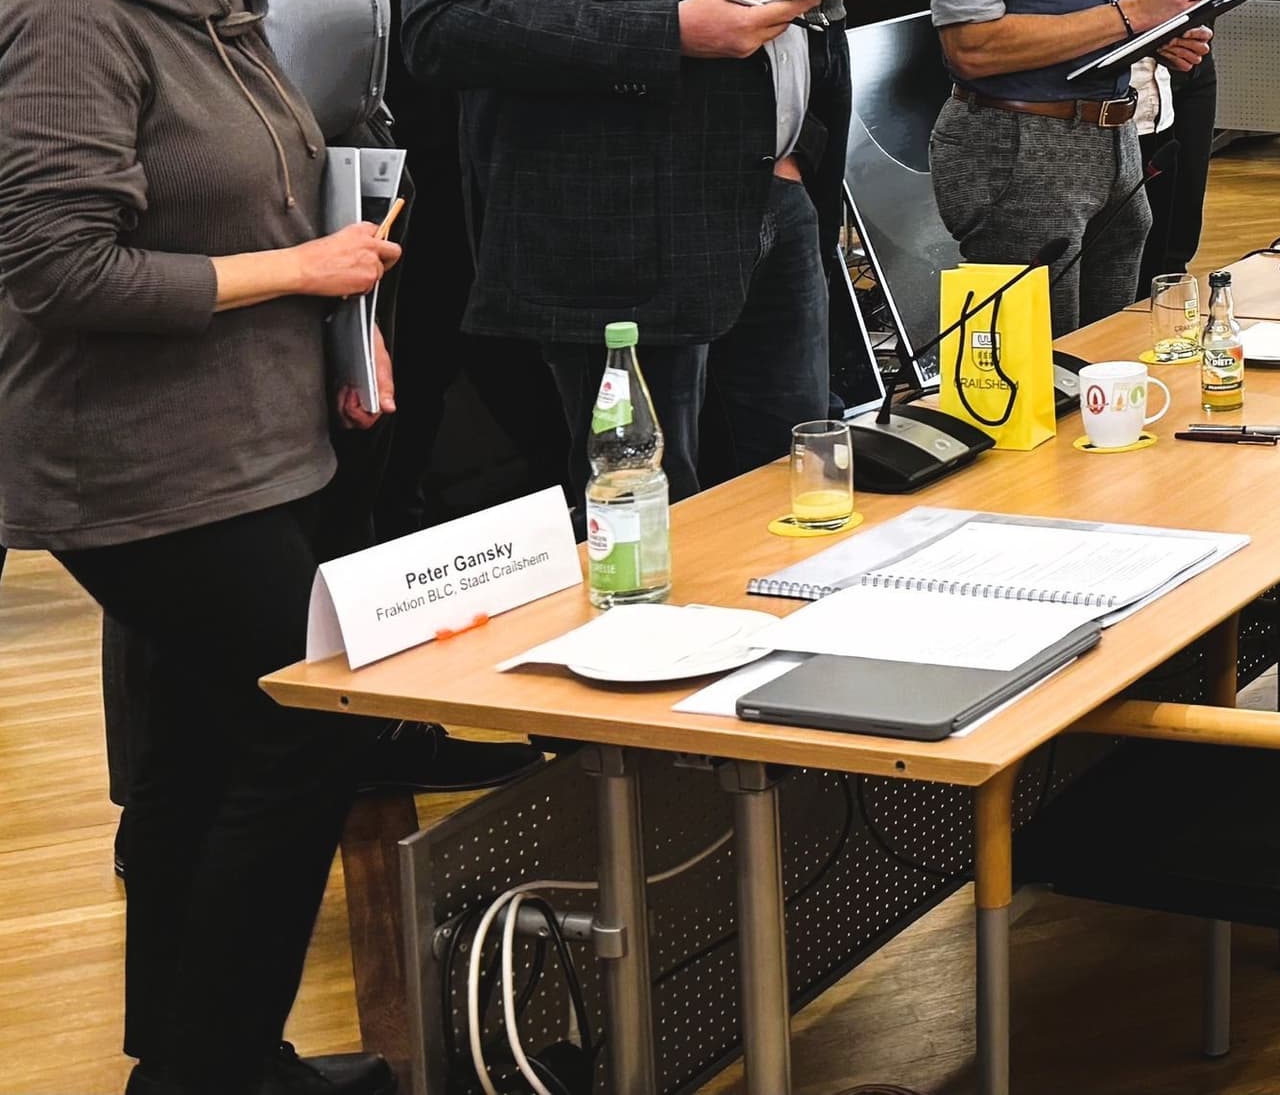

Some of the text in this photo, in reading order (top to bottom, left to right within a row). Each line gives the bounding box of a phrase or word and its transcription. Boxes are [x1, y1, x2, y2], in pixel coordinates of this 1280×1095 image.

[954, 377, 1020, 391] RAILSHE
[375, 596, 426, 621] Fraktion
[459, 571, 491, 591] Stadt
[491, 551, 550, 579] Crailsheim
[405, 541, 513, 589] Peter Gansky
